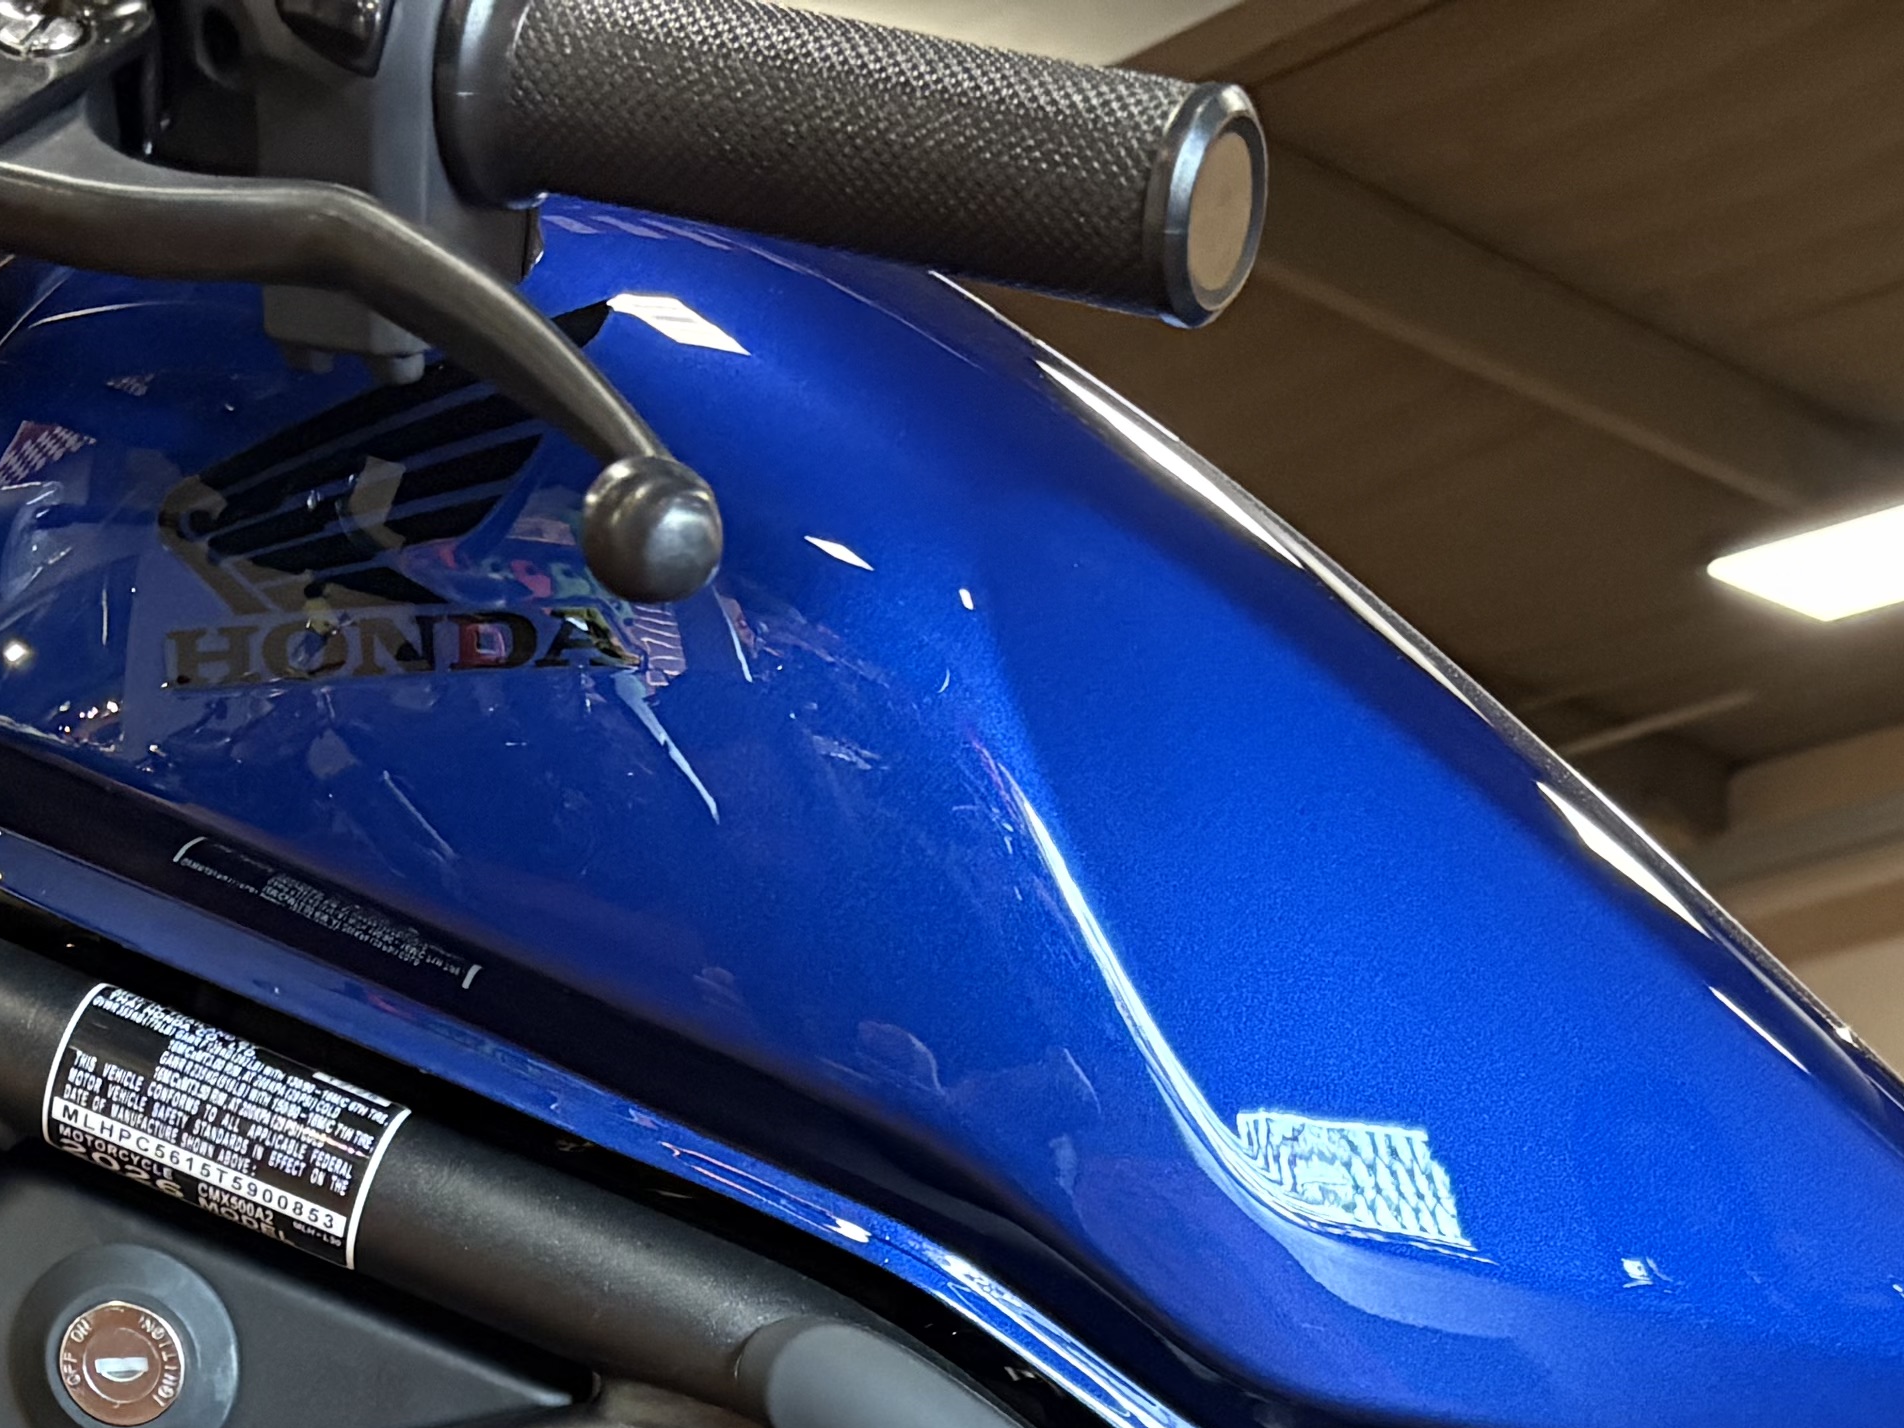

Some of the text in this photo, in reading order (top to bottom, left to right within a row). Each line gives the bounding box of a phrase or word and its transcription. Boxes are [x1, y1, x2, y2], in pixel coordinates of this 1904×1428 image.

[169, 609, 646, 689] HONDA
[63, 1083, 89, 1106] DATE
[91, 1095, 106, 1112] OF
[110, 1103, 178, 1146] MANUFACTURE
[176, 1132, 214, 1161] SHOWN
[67, 1066, 348, 1196] MOTOR VEHICLE SAFETY STANDARDS IN EFFECT ON THE
[73, 1048, 352, 1182] THIS VEHICLE CONFORMS TO ALL APPLICABLE FEDERAL
[60, 1126, 173, 1181] MOTORCYCLE
[197, 1182, 273, 1224] CMX500A2
[60, 1137, 294, 1245] 2026 MODEL
[62, 1104, 333, 1233] MLHPC5615T5900853
[63, 1352, 81, 1387] OFF
[71, 1317, 93, 1343] ON
[139, 1315, 178, 1407] IGNITION
